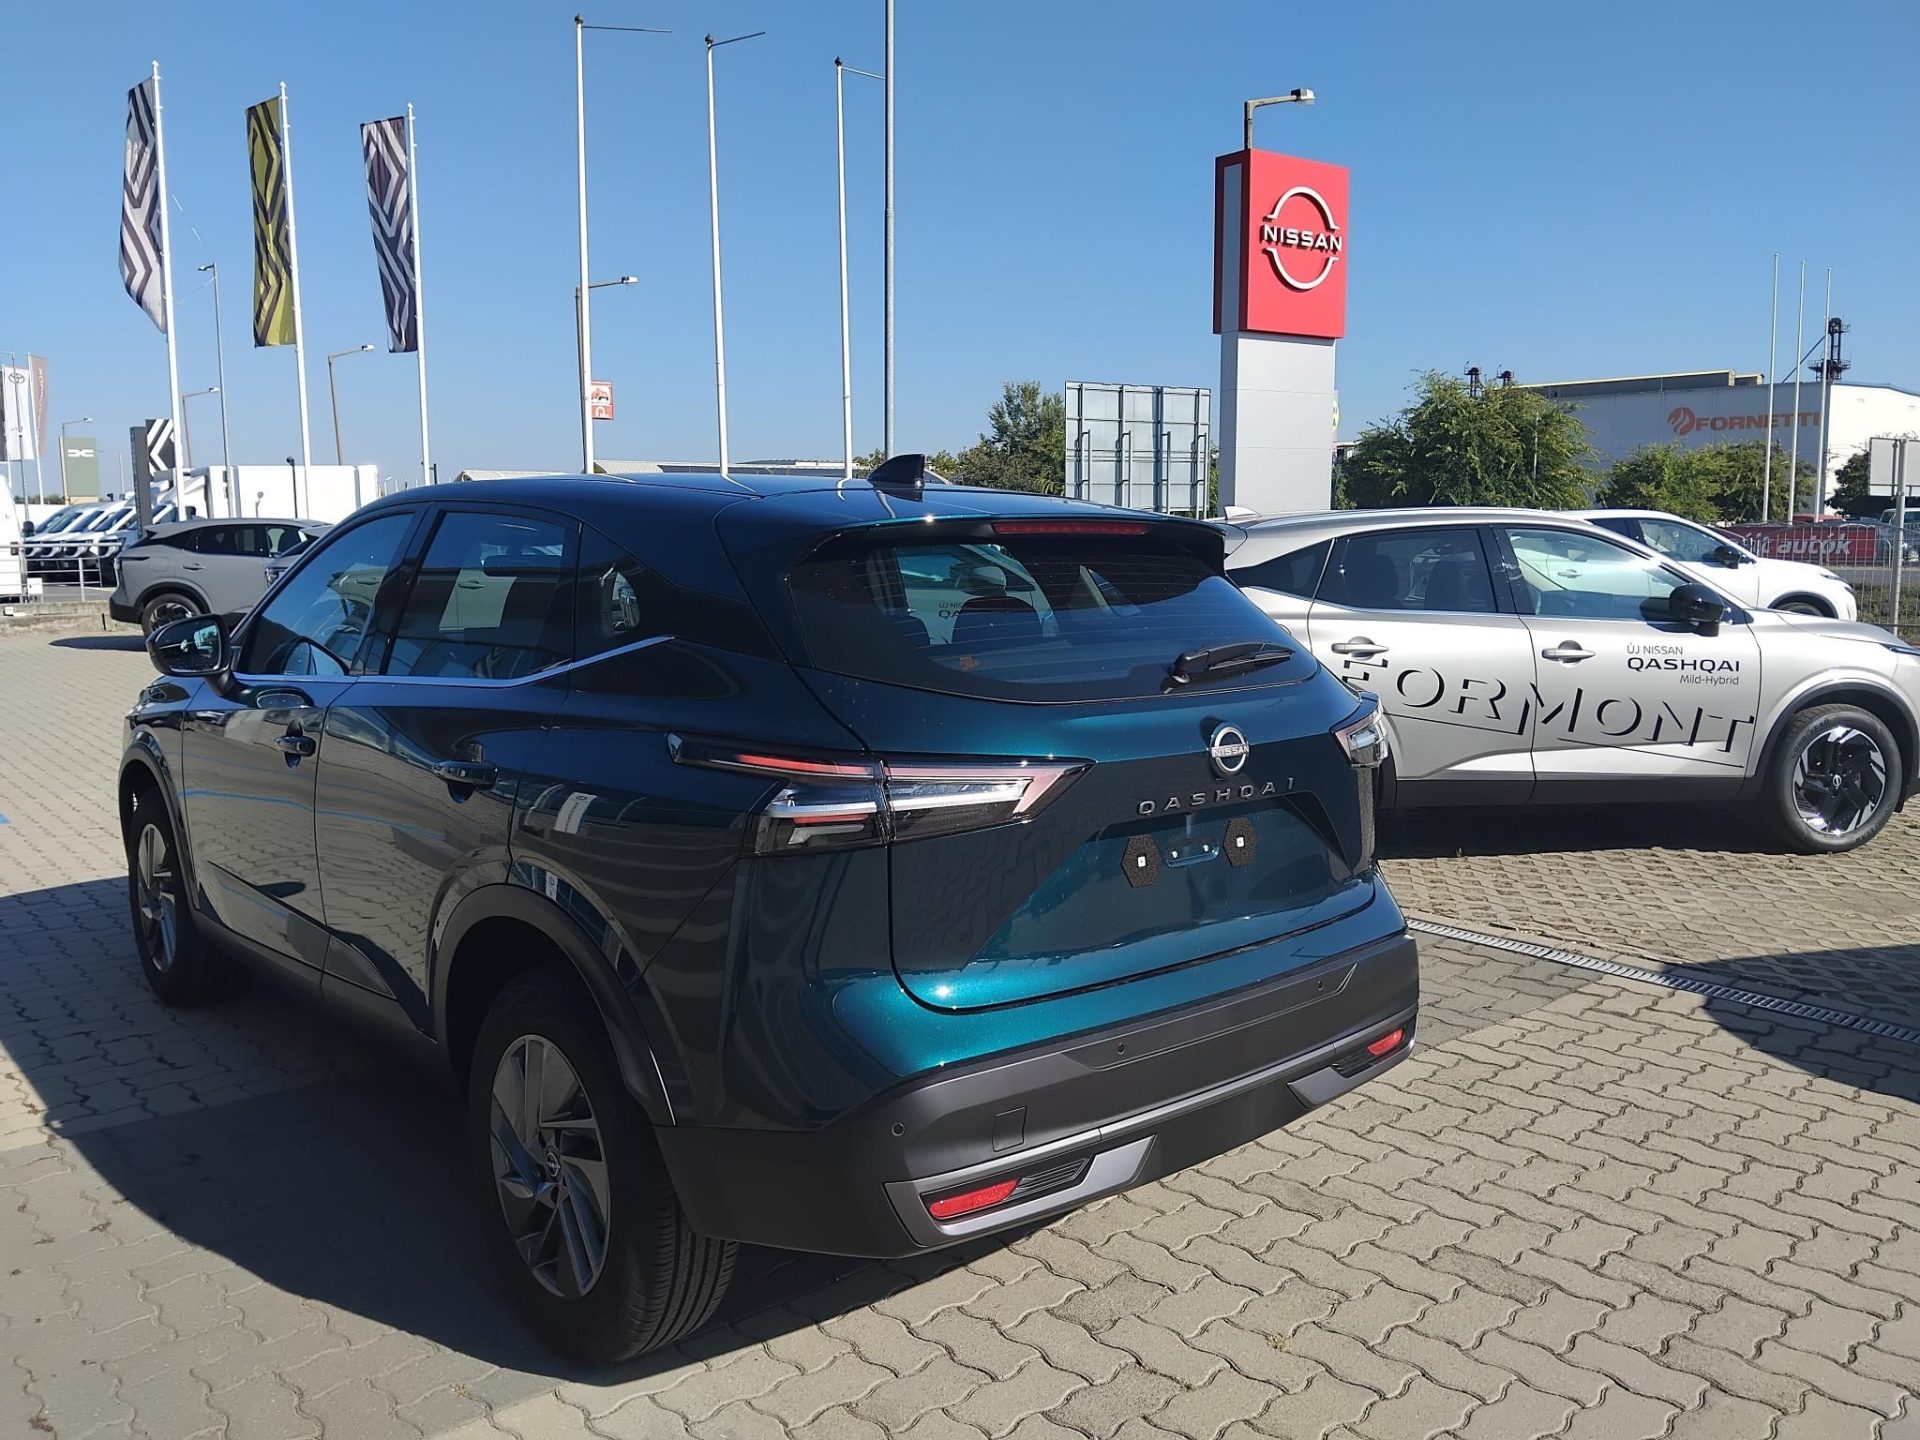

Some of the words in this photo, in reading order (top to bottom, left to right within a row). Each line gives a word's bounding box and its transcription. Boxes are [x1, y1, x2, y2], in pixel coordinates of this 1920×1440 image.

[1263, 224, 1342, 251] NISSAN
[1696, 411, 1821, 431] FORNETTI
[1626, 642, 1641, 655] ÚJ
[1643, 645, 1684, 655] NISSAN
[1627, 657, 1740, 674] QASHQAI
[1680, 675, 1740, 686] Mild-Hybrid
[1212, 743, 1249, 757] NISSAN
[1139, 777, 1294, 816] QASHQAI
